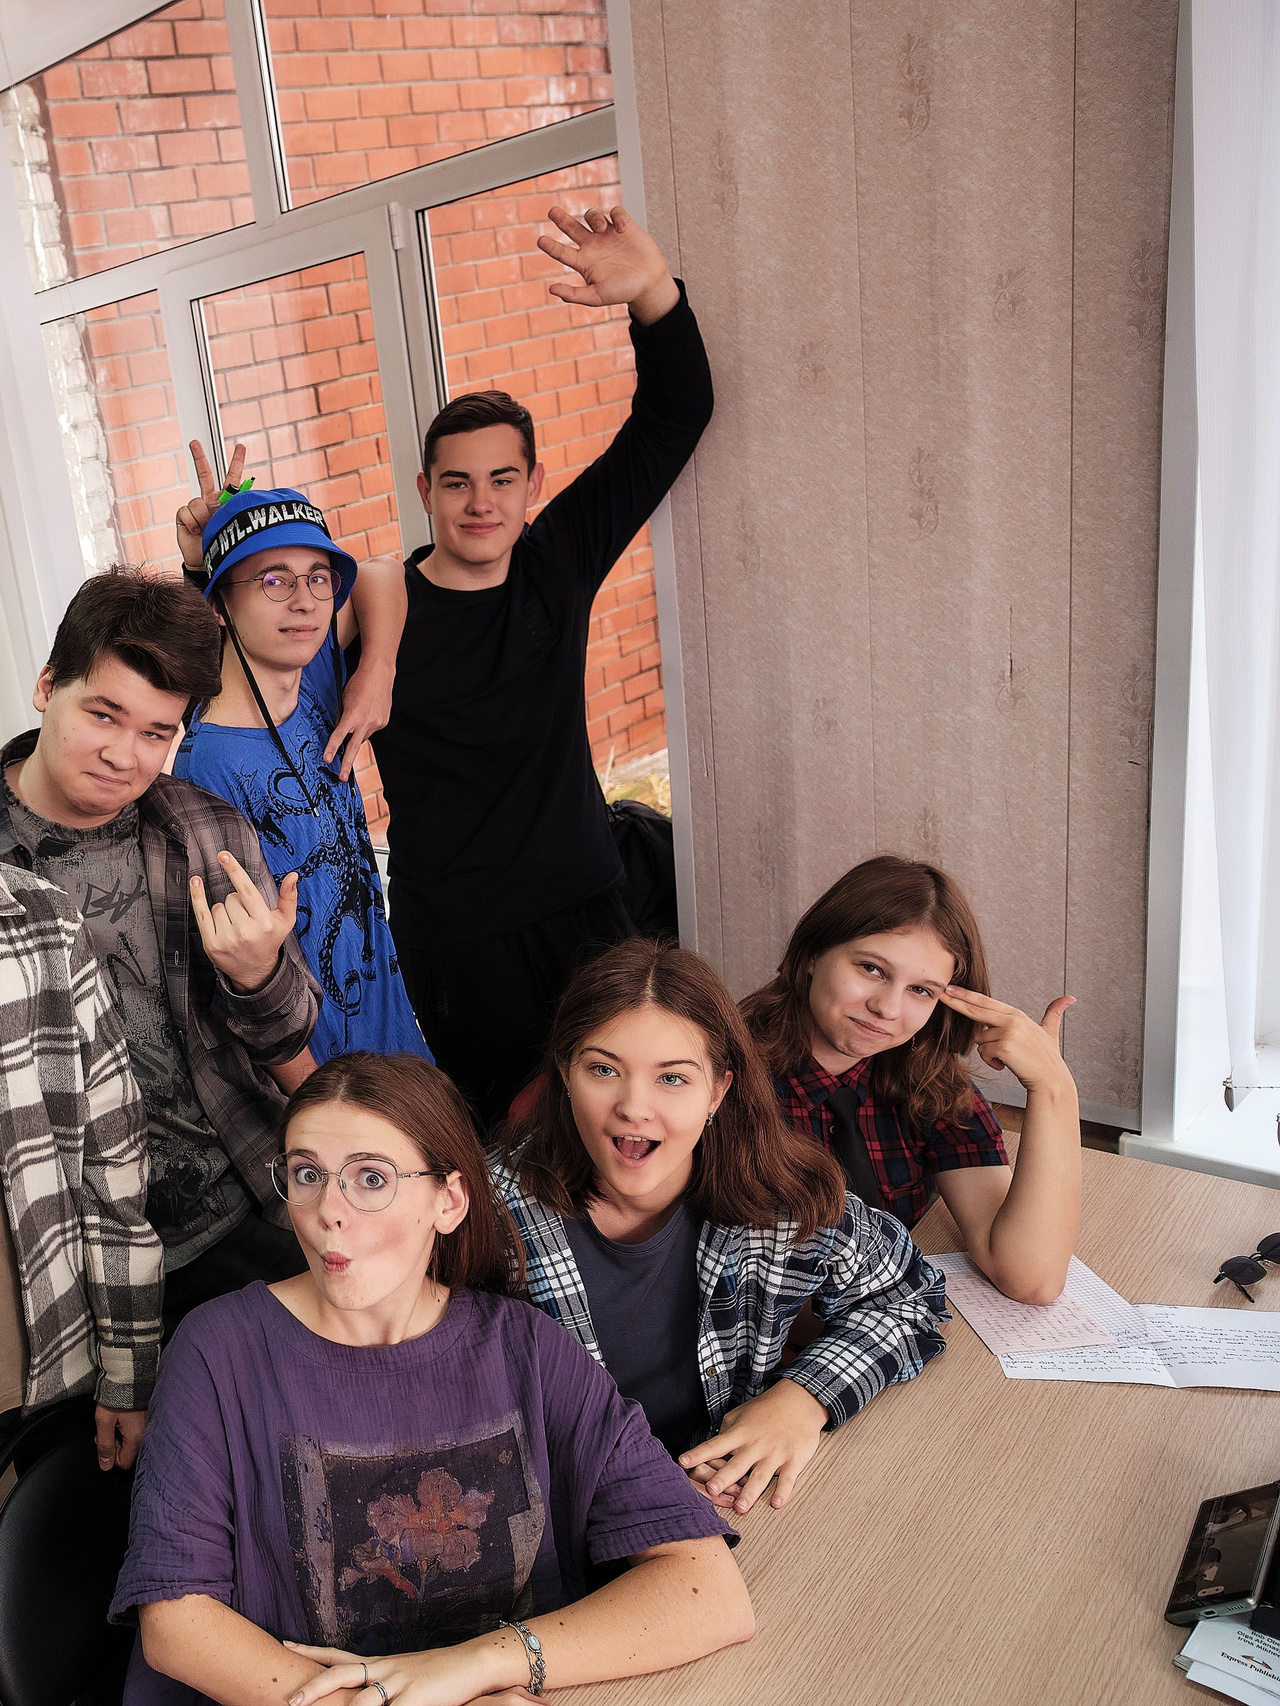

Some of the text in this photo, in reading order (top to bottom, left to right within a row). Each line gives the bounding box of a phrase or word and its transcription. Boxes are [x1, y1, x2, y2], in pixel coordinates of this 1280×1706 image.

[1255, 1638, 1280, 1652] Afanas
[1221, 1652, 1280, 1681] Express Publishi
